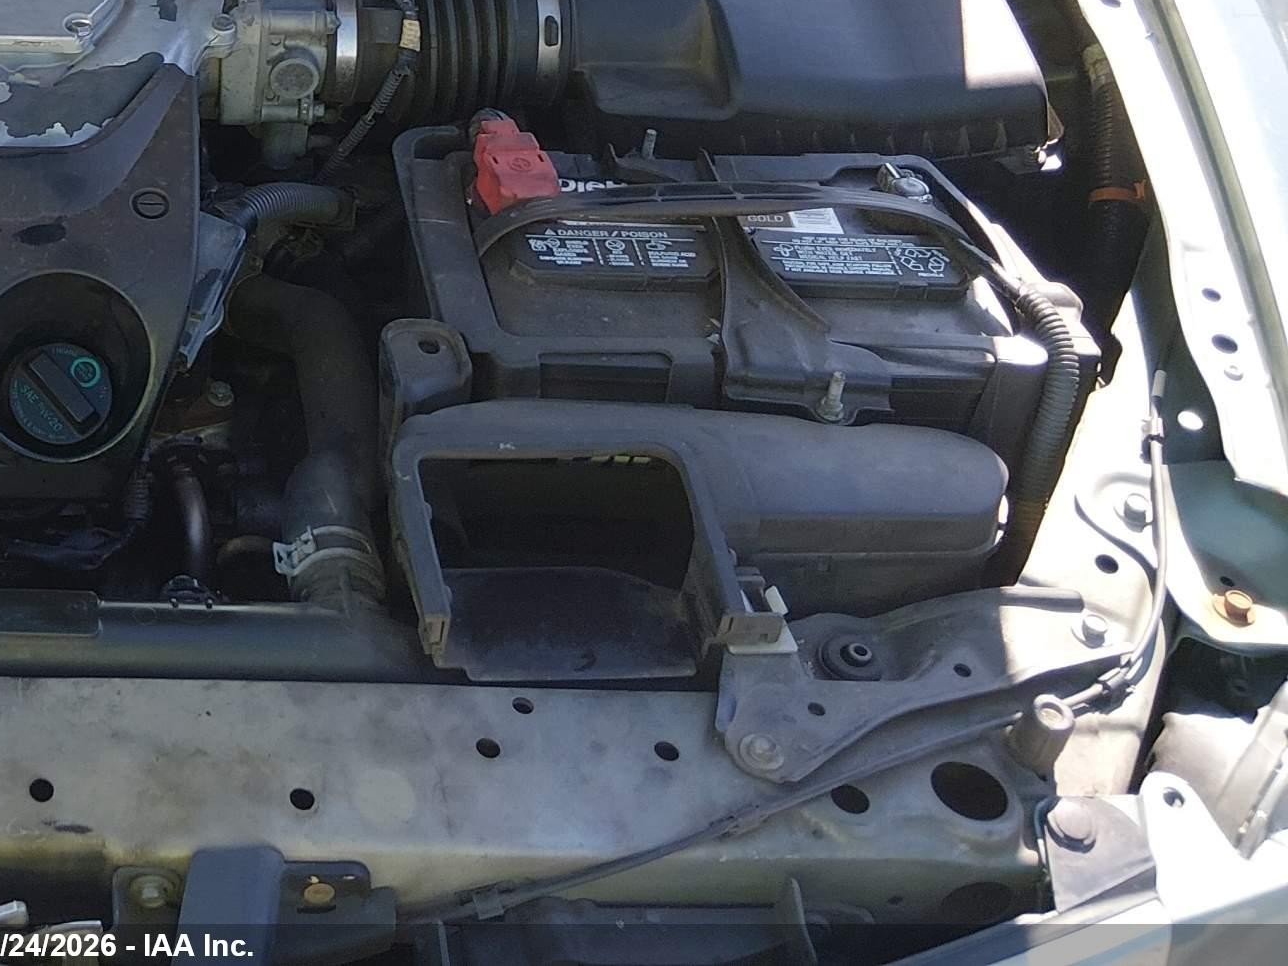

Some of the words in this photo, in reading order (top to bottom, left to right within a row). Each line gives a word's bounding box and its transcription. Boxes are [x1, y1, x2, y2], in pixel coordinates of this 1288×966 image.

[747, 215, 784, 223] GOLD
[557, 229, 608, 237] DANGER
[620, 230, 668, 238] POISON
